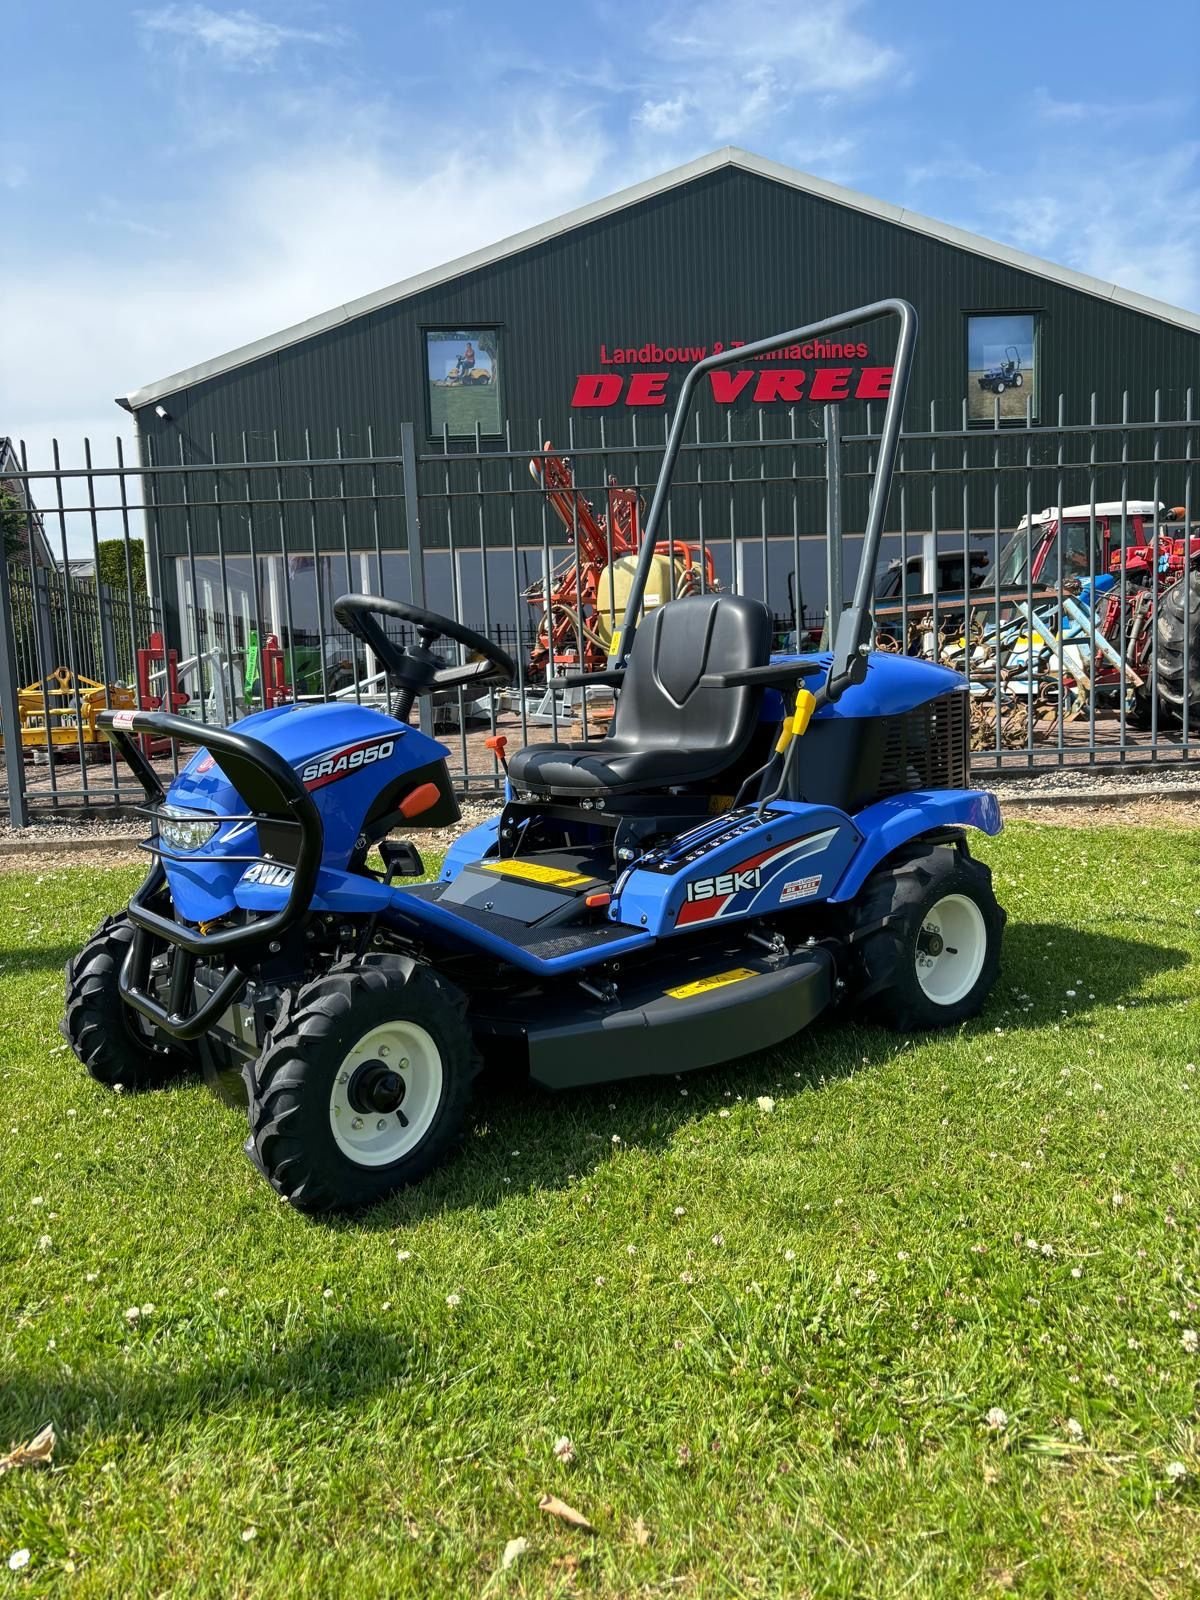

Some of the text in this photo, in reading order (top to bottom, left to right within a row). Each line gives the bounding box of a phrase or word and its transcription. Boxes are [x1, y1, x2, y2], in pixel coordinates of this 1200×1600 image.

[600, 343, 706, 365] Landbouw
[570, 367, 896, 407] DE VREE
[302, 741, 395, 782] SRA950
[243, 863, 296, 887] 4WD
[687, 868, 761, 903] ISEKI
